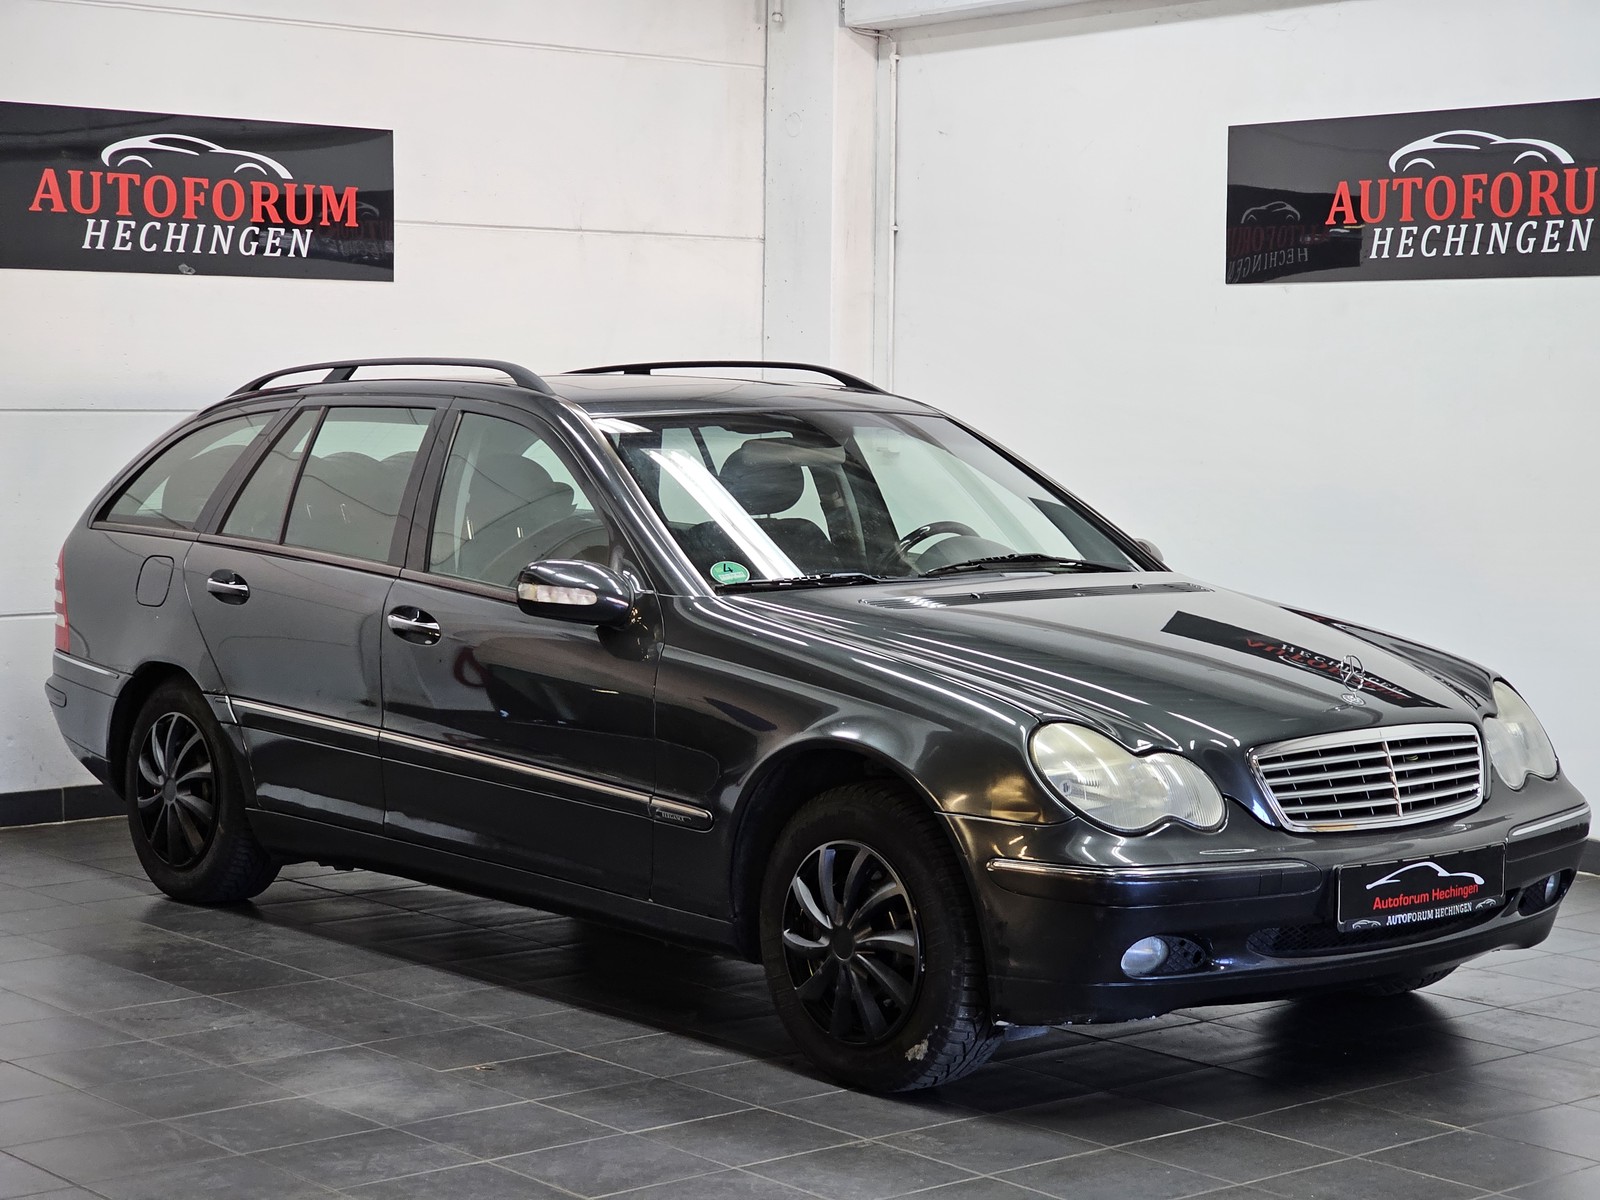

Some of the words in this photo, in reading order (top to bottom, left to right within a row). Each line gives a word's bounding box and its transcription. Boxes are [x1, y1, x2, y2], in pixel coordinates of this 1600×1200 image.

[29, 168, 358, 227] AUTOFORUM
[82, 219, 313, 258] HECHINGEN
[1369, 218, 1594, 259] HECHINGEN
[723, 563, 733, 573] 4
[1373, 892, 1429, 910] Autoforum
[1432, 883, 1479, 901] Hechingen
[1386, 909, 1434, 926] AUTOFORUM
[1435, 902, 1472, 919] HECHINGEN
